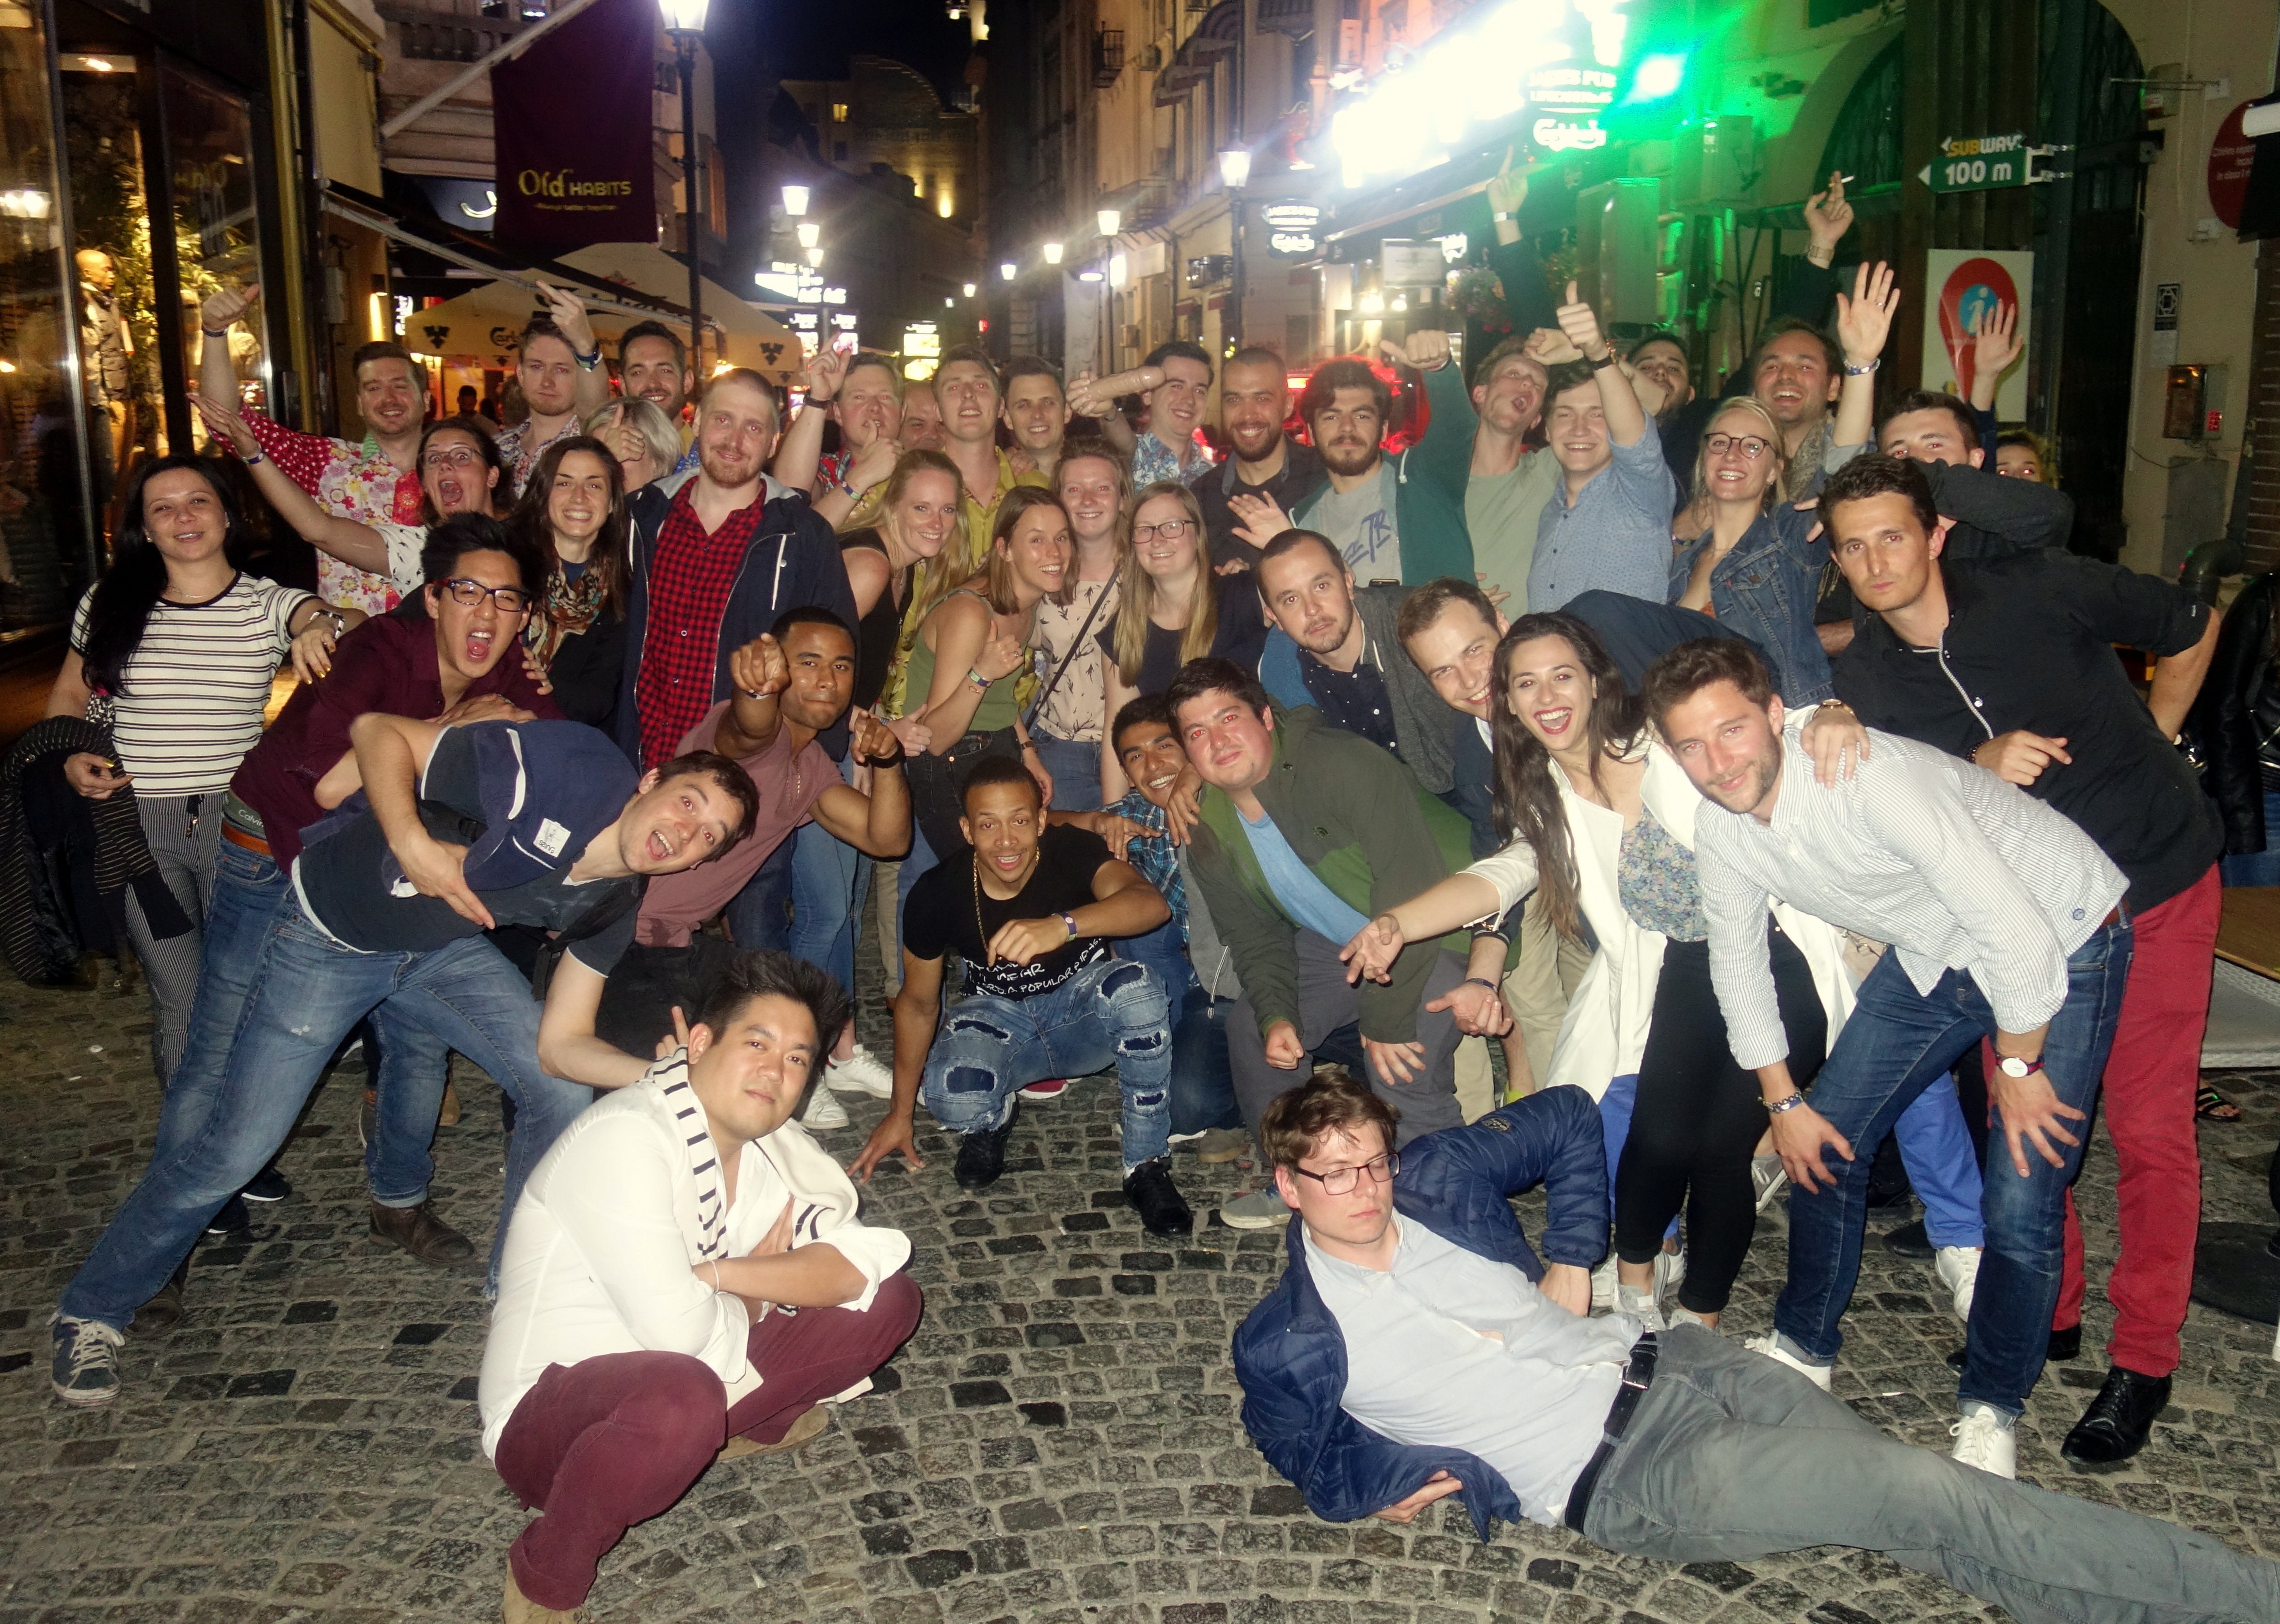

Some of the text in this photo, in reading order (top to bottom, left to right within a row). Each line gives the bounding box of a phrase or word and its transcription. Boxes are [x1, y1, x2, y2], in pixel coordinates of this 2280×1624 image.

[1942, 132, 2025, 158] SUBWAY
[518, 169, 632, 197] Old HABITS
[1945, 160, 2012, 185] 100 m
[1019, 967, 1074, 993] POPULAR
